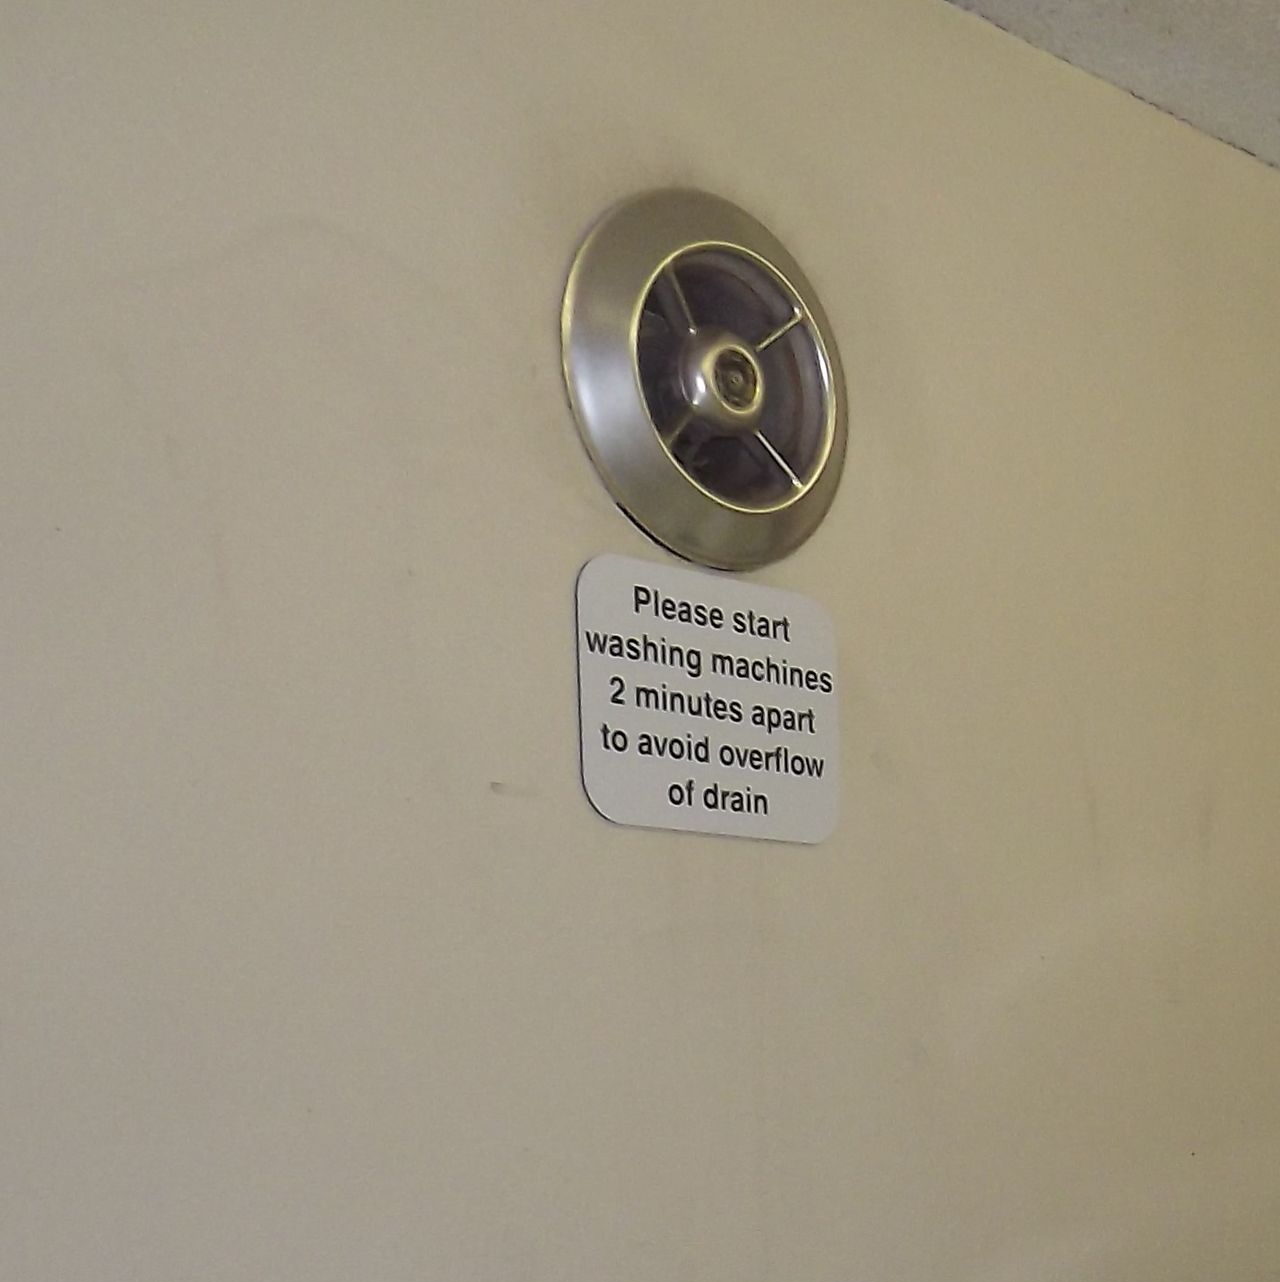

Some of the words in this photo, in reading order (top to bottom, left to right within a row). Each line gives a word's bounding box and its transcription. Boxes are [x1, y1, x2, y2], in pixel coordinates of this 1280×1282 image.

[633, 585, 724, 629] Please
[732, 610, 791, 643] start
[585, 630, 702, 678] washing
[711, 653, 833, 693] machines
[609, 676, 626, 706] 2
[635, 683, 743, 723] minutes
[751, 705, 816, 735] apart
[600, 723, 628, 753] to
[637, 733, 710, 763] avoid
[719, 744, 825, 778] overflow
[668, 779, 695, 807] of
[703, 782, 768, 815] drain
